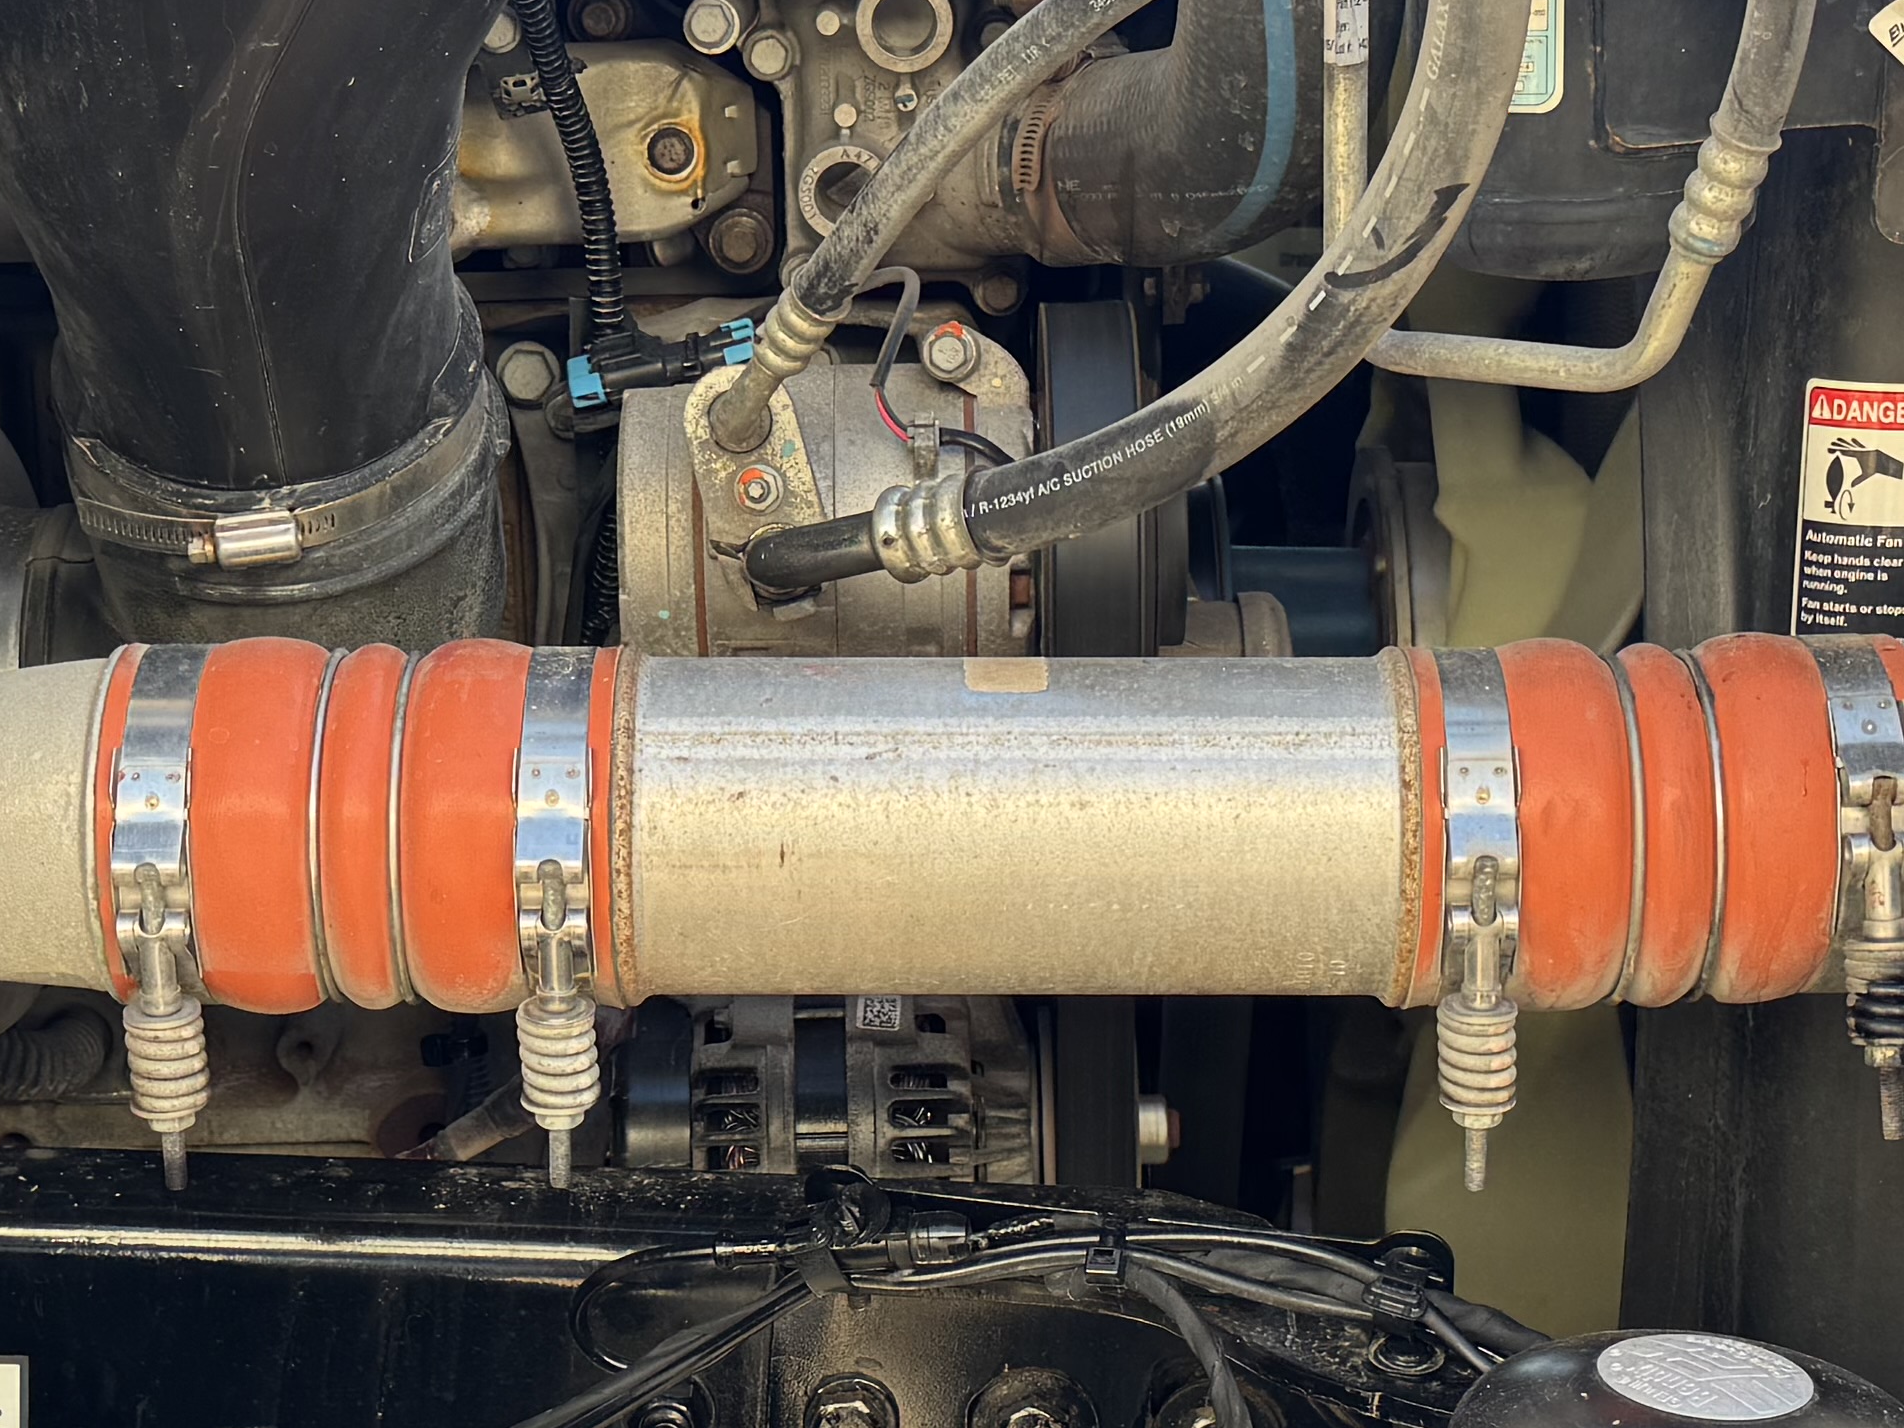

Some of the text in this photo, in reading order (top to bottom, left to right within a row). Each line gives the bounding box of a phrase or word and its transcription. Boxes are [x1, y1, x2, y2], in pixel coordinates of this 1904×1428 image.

[979, 486, 1035, 515] R-1234yf
[1038, 477, 1061, 500] A/C
[1063, 450, 1123, 487] SUCTION
[1126, 428, 1165, 458] HOSE
[1805, 529, 1904, 549] Automatic Fan
[1804, 550, 1904, 568] Keep hands clear
[1803, 565, 1889, 582] when engine is
[1802, 580, 1848, 596] running.
[1801, 597, 1821, 610] Fan
[1822, 601, 1858, 614] starts
[1859, 605, 1874, 614] or
[1800, 610, 1848, 627] by itself.
